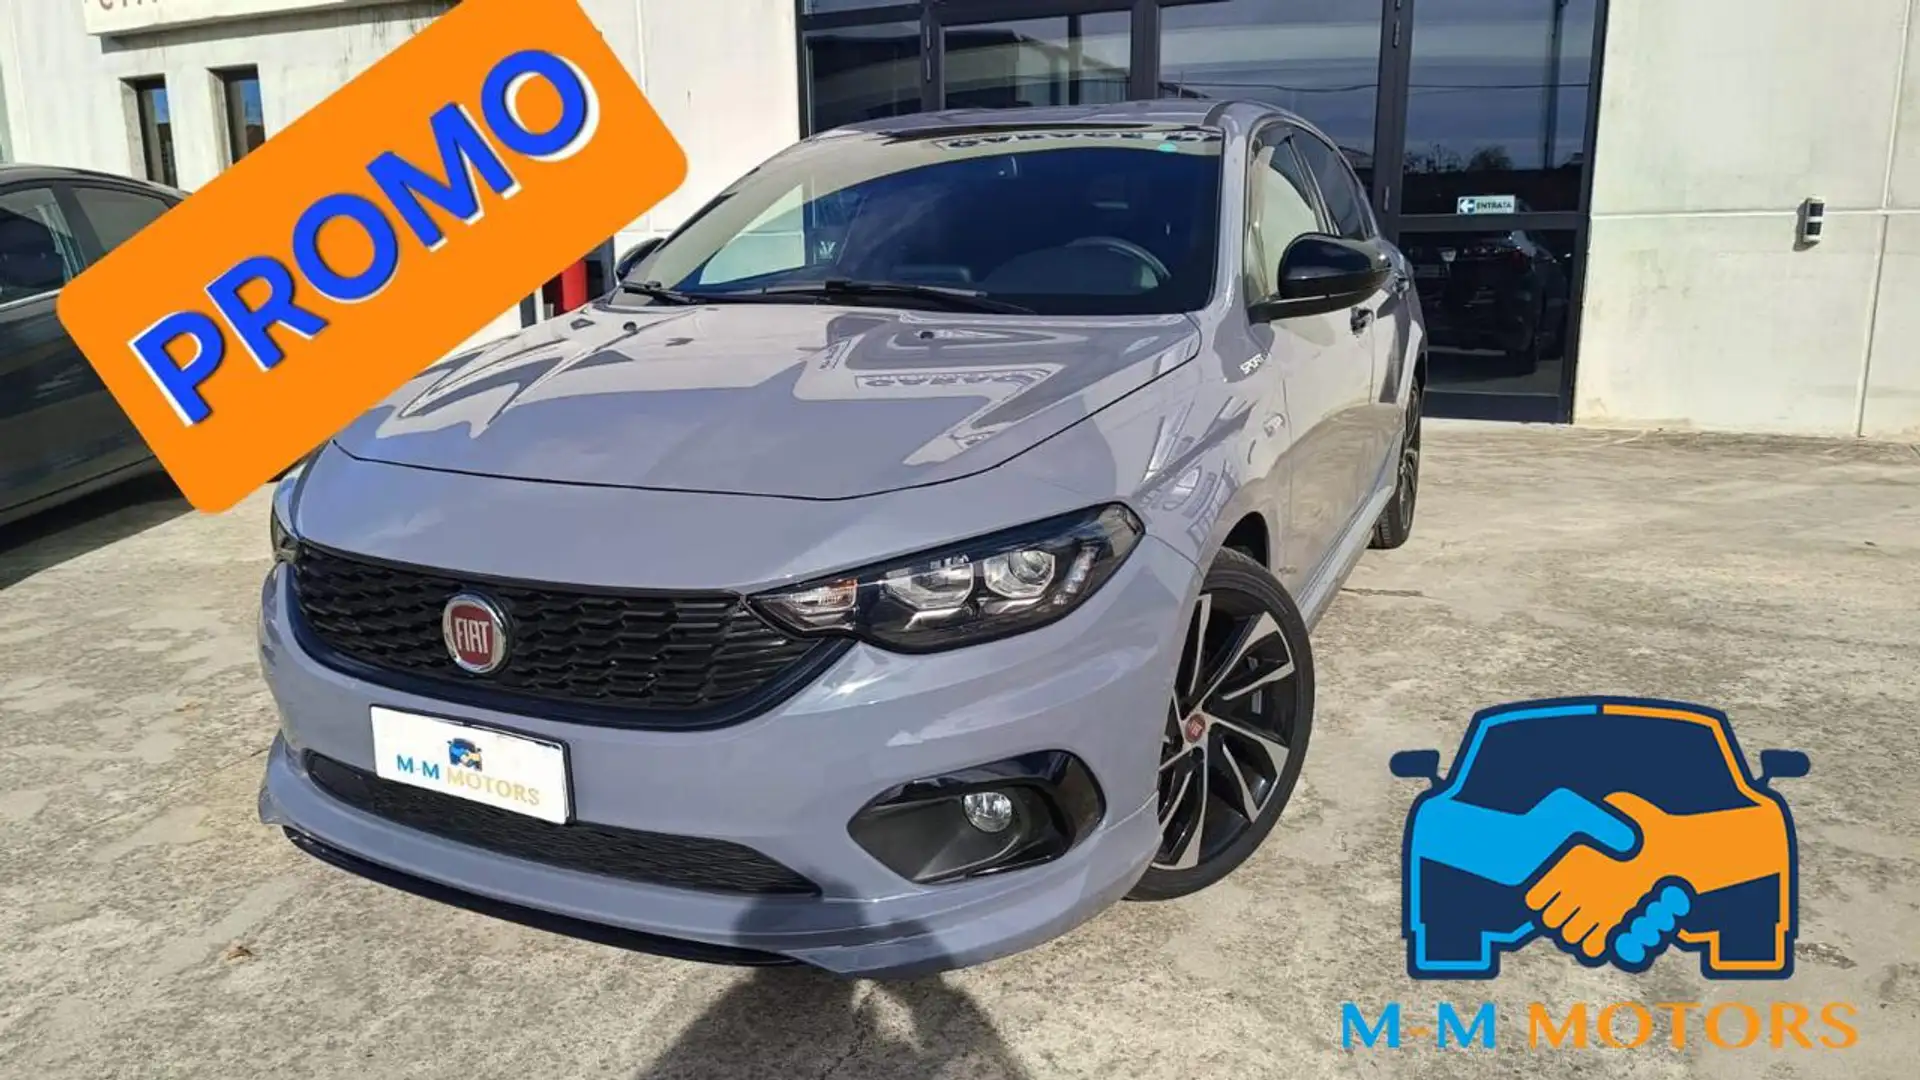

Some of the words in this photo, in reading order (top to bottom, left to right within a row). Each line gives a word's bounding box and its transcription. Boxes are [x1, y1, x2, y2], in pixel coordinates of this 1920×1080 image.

[1476, 201, 1513, 209] ENTRATA
[454, 617, 490, 654] FIAT
[396, 754, 440, 780] M-M
[447, 766, 541, 806] MOTORS
